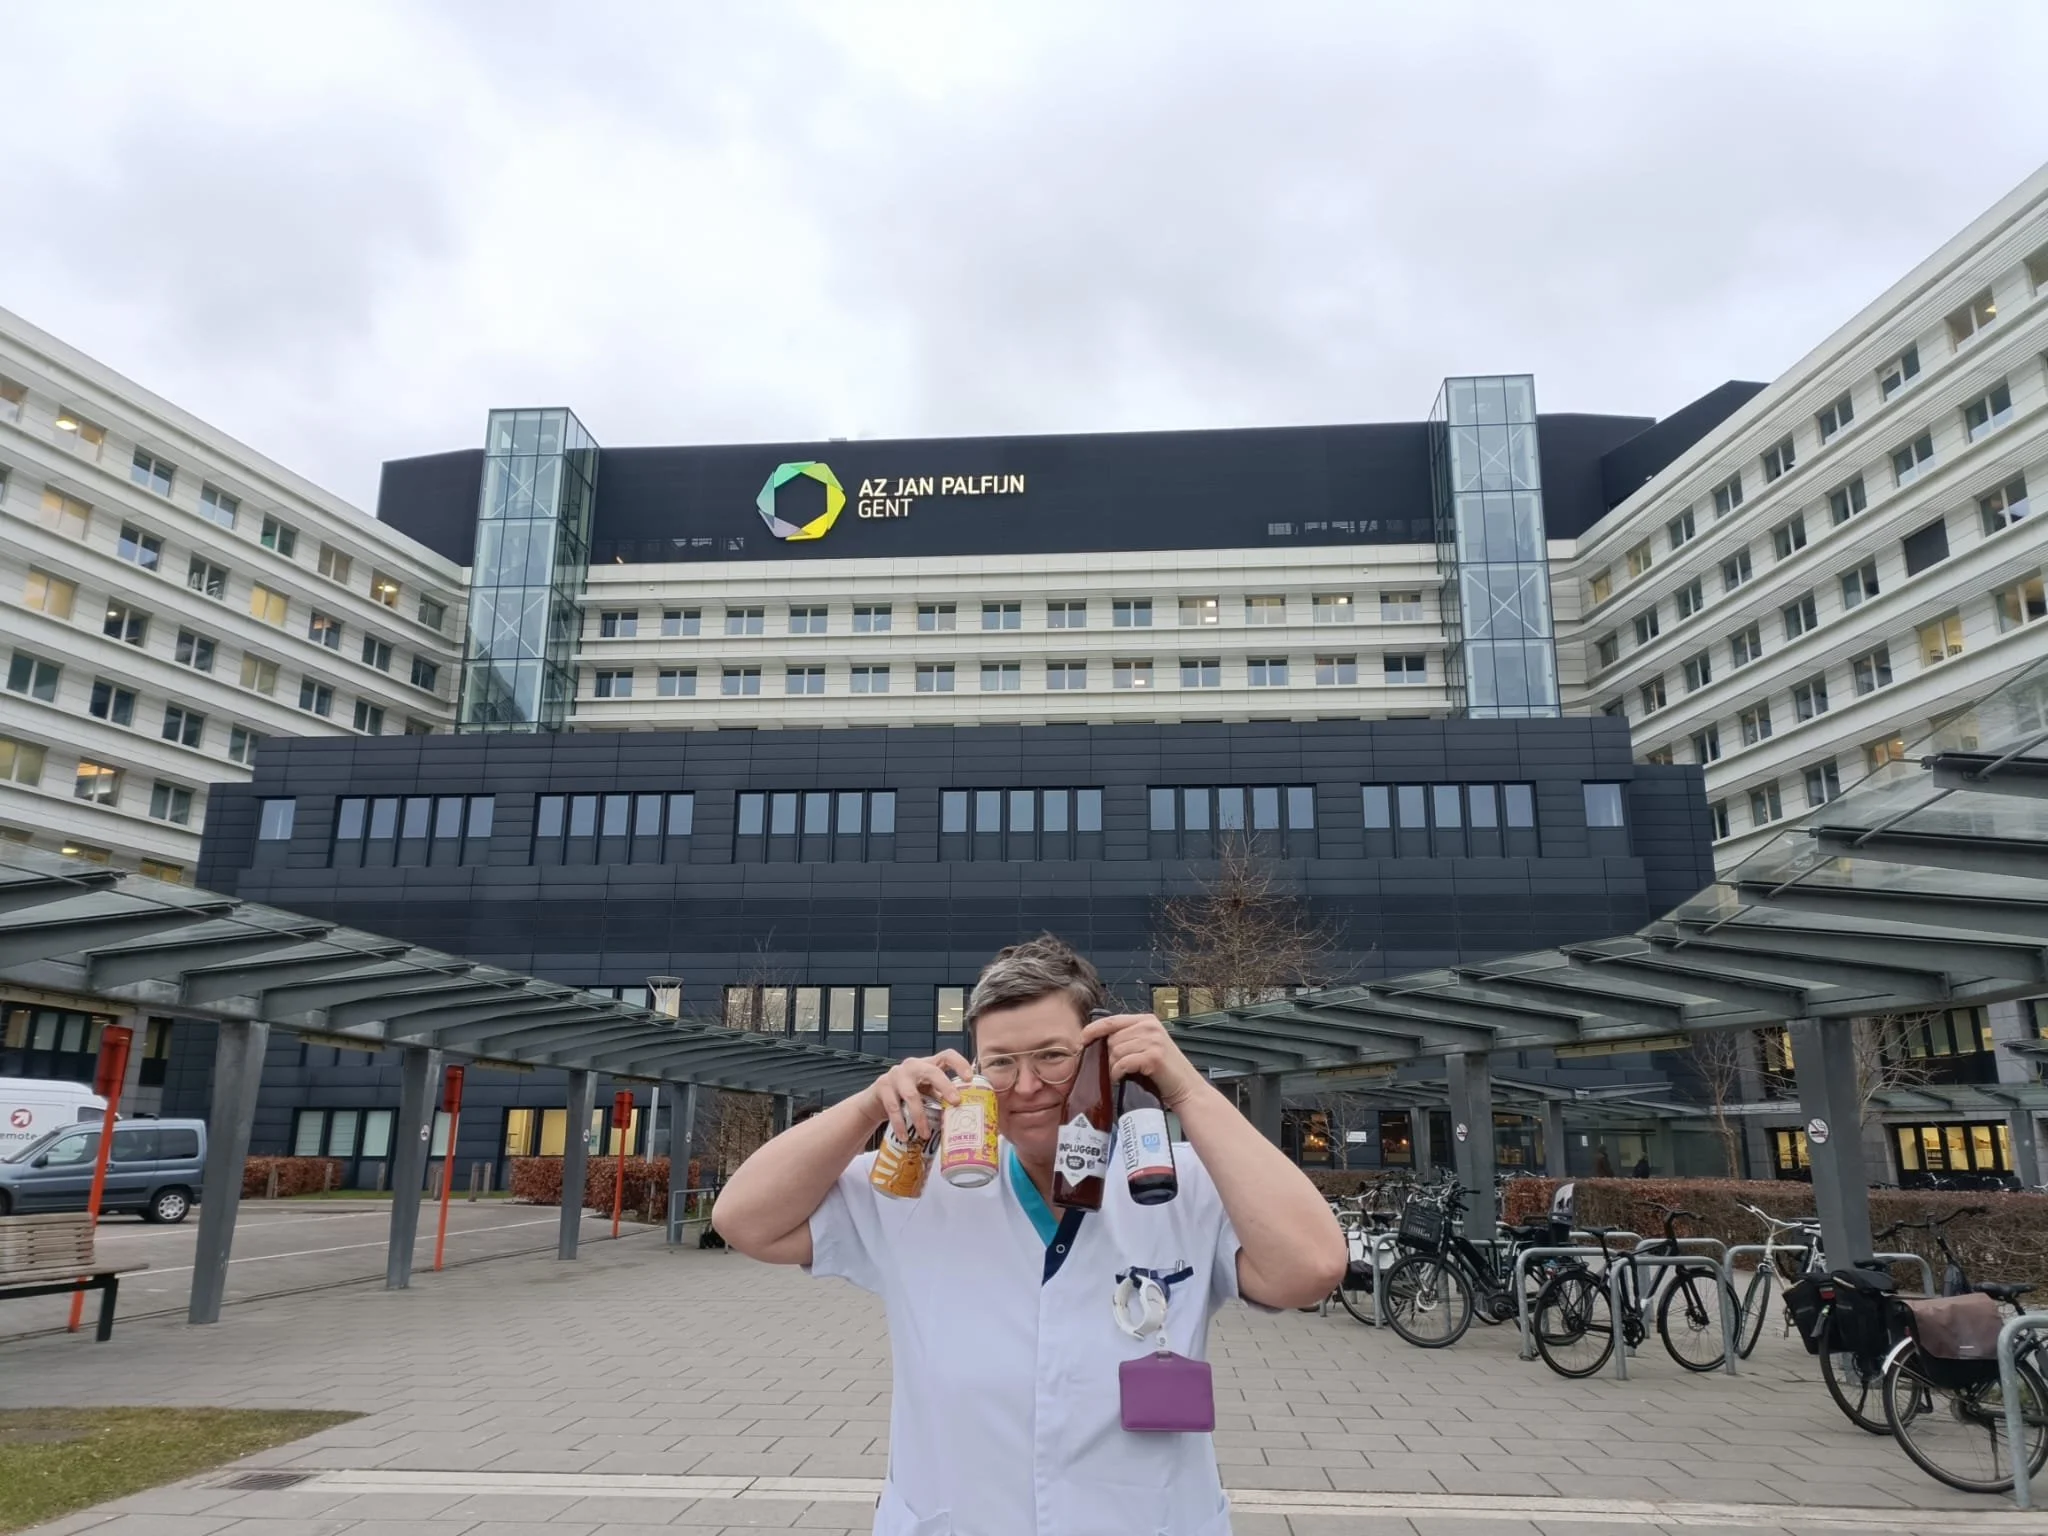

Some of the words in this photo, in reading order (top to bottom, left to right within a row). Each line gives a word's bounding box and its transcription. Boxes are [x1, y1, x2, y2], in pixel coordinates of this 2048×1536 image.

[858, 478, 887, 497] AZ
[894, 477, 934, 496] JAN
[941, 475, 1025, 495] PALFIJN
[858, 498, 913, 518] GENT
